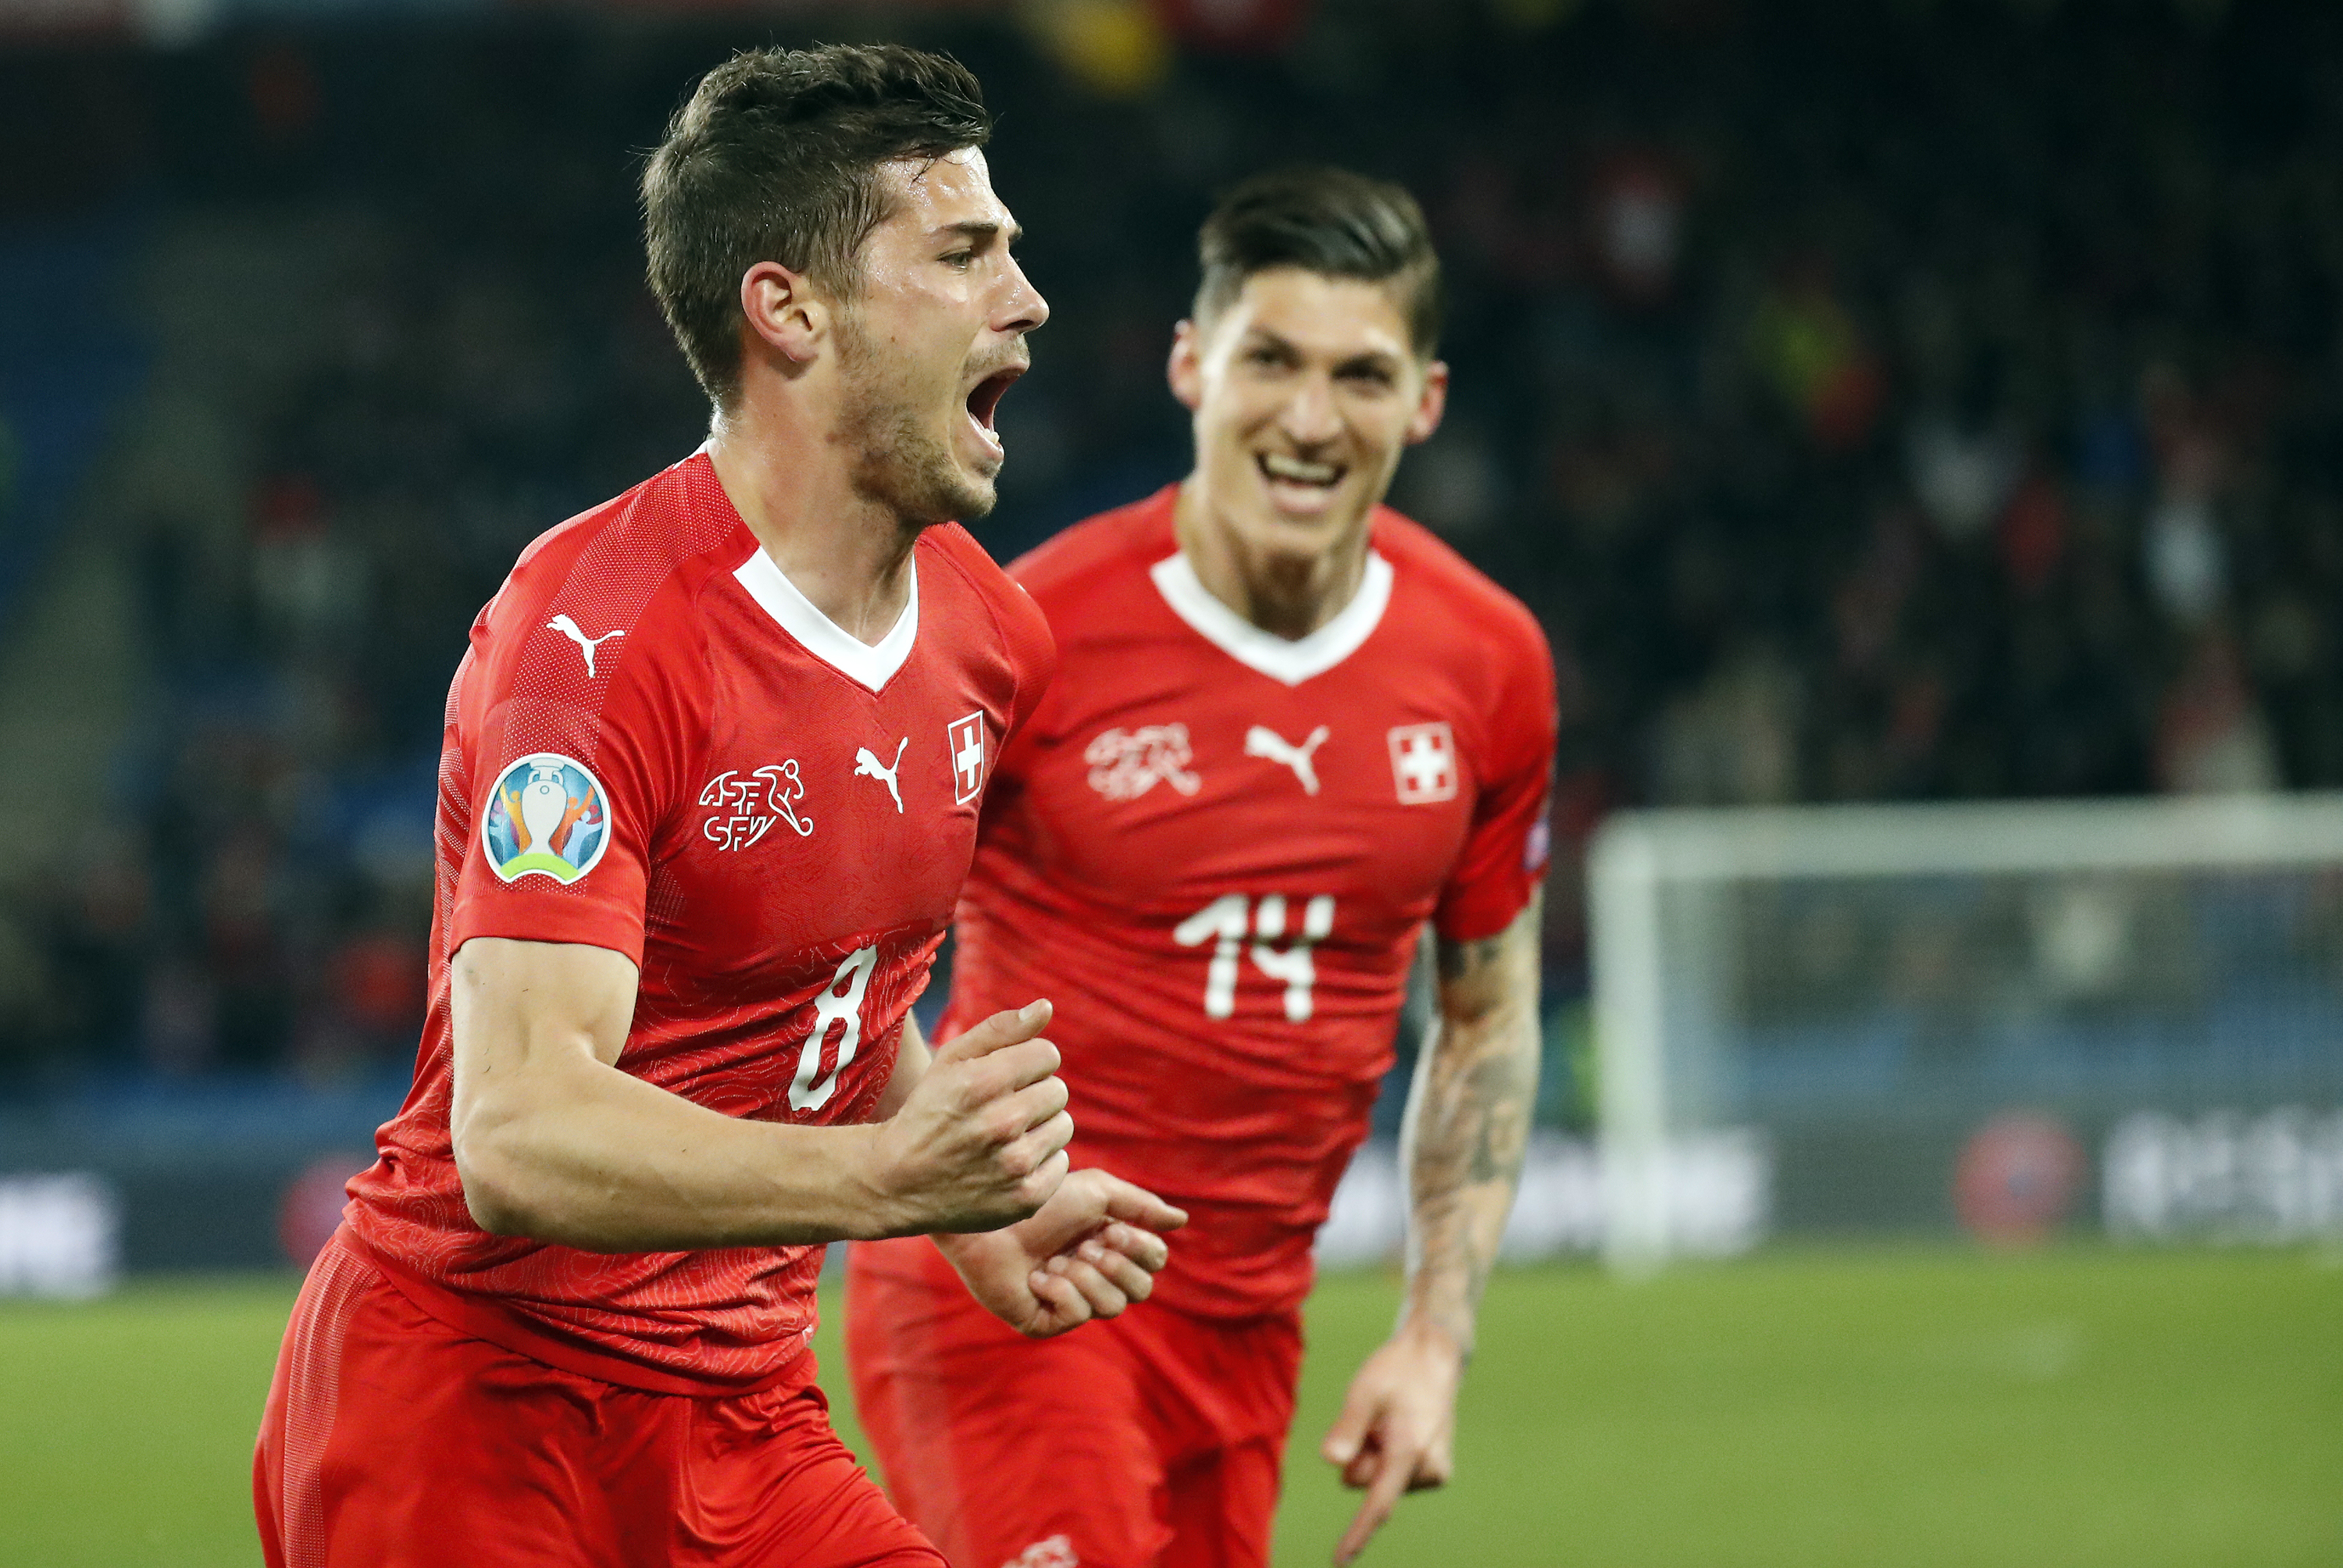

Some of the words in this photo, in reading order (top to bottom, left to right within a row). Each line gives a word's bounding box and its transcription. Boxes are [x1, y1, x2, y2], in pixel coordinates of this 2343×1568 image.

[698, 770, 761, 815] ASF
[1174, 893, 1334, 1023] 14
[788, 944, 878, 1111] 8
